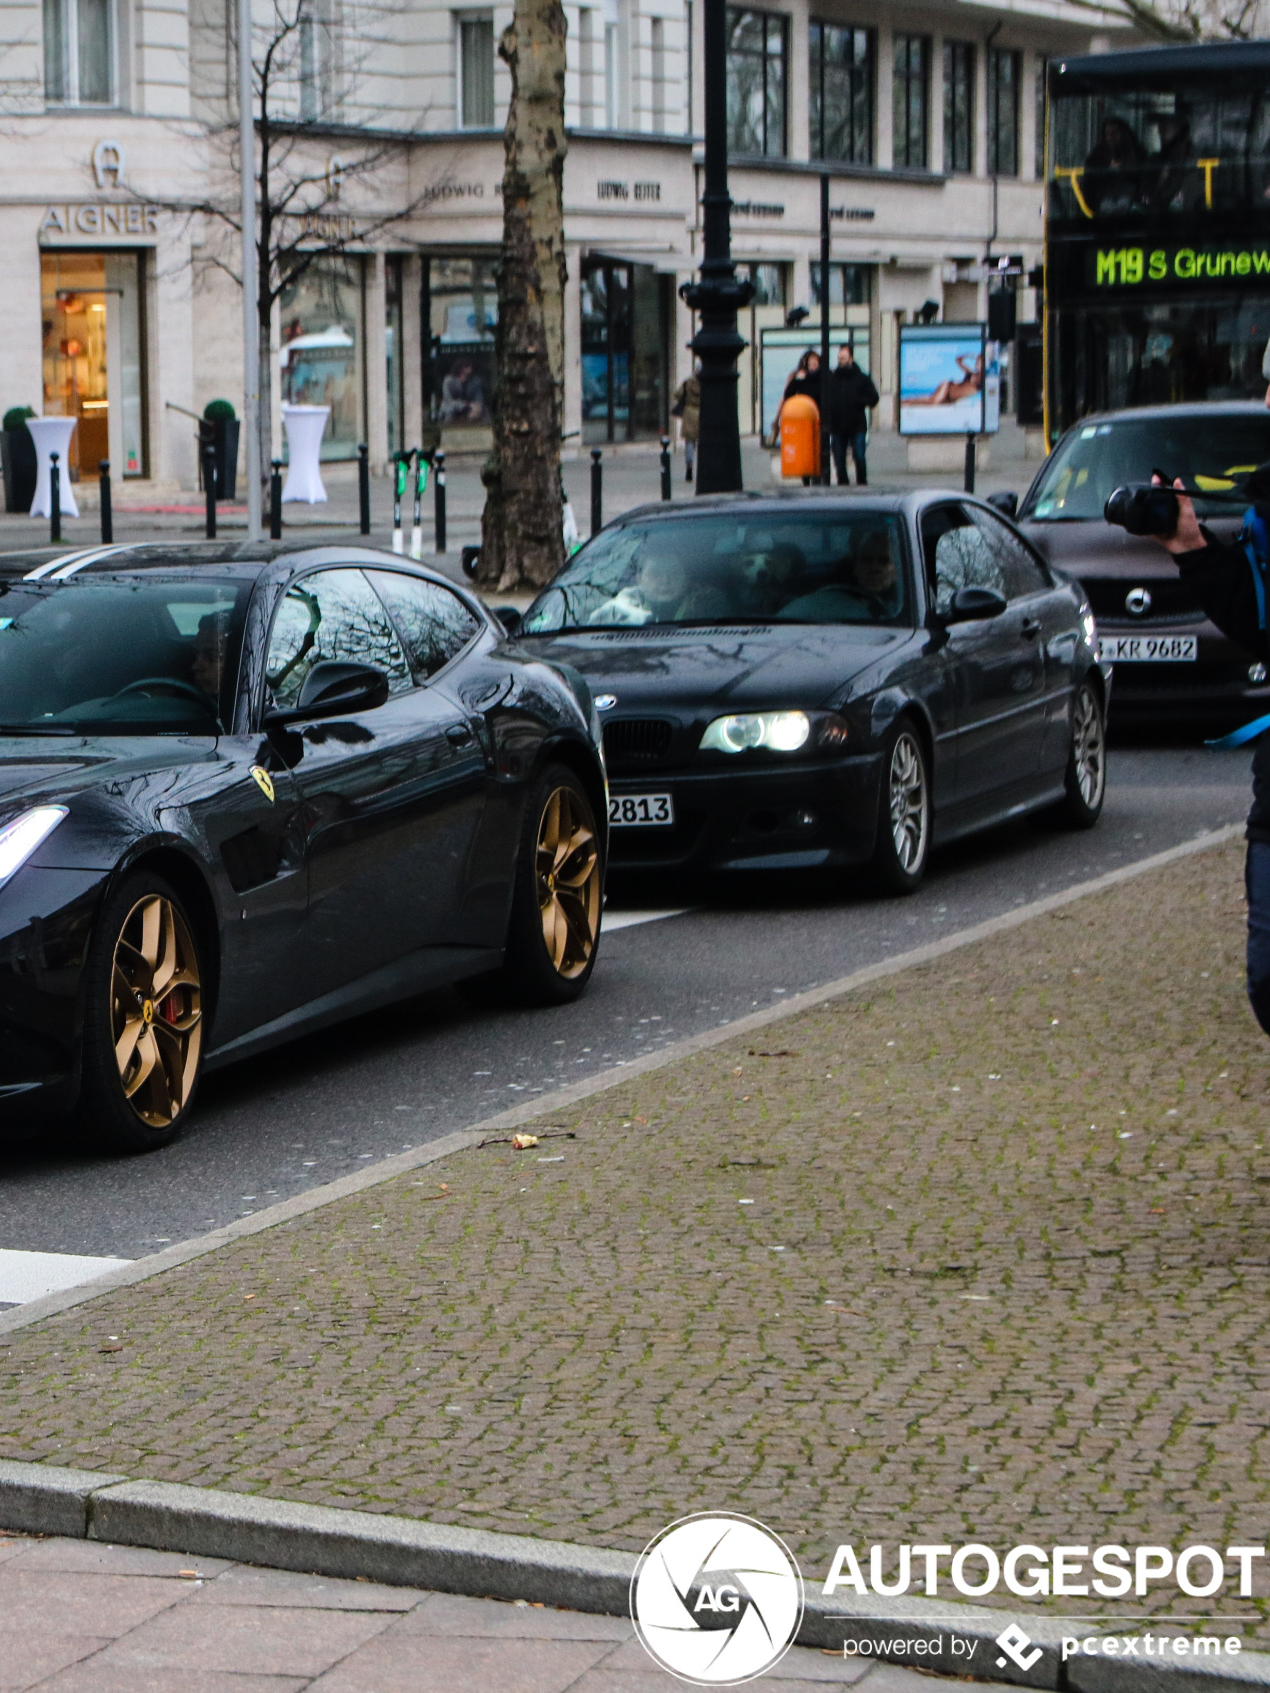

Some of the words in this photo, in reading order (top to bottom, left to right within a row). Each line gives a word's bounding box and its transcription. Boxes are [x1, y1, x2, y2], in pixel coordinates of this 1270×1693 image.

[42, 203, 158, 234] AIGNER
[1096, 247, 1144, 285] M19
[1148, 249, 1168, 280] S
[1117, 640, 1140, 658] KR
[1146, 639, 1194, 658] 9682
[609, 798, 669, 822] 2813
